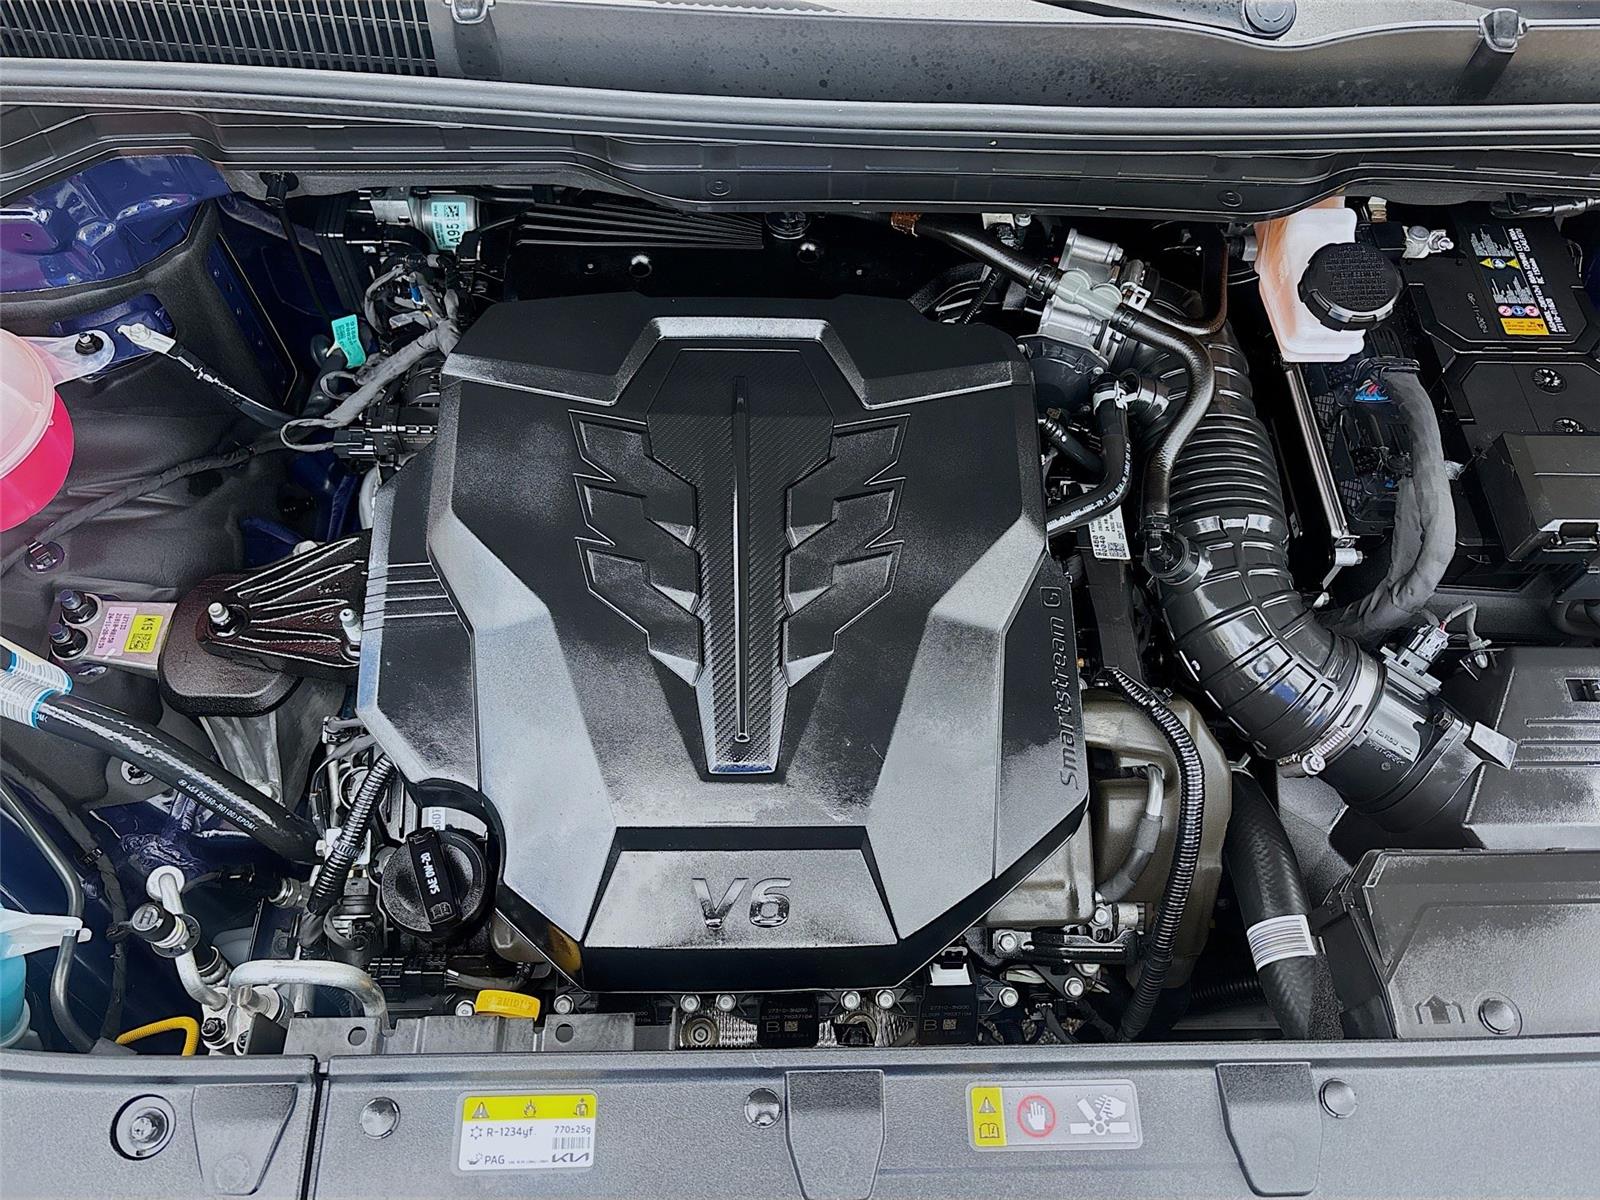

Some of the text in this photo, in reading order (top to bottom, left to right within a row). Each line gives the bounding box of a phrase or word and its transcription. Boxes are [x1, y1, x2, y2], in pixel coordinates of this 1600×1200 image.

[446, 223, 460, 243] A95
[141, 617, 156, 631] K15
[1050, 616, 1078, 790] Smartstream
[420, 852, 440, 895] SAE 0W-20
[692, 876, 792, 930] V6
[139, 909, 153, 925] H
[766, 1021, 780, 1033] B
[924, 1019, 938, 1031] B
[554, 1125, 591, 1135] 770±25g
[484, 1155, 505, 1165] PAG
[552, 1152, 590, 1163] KIA
